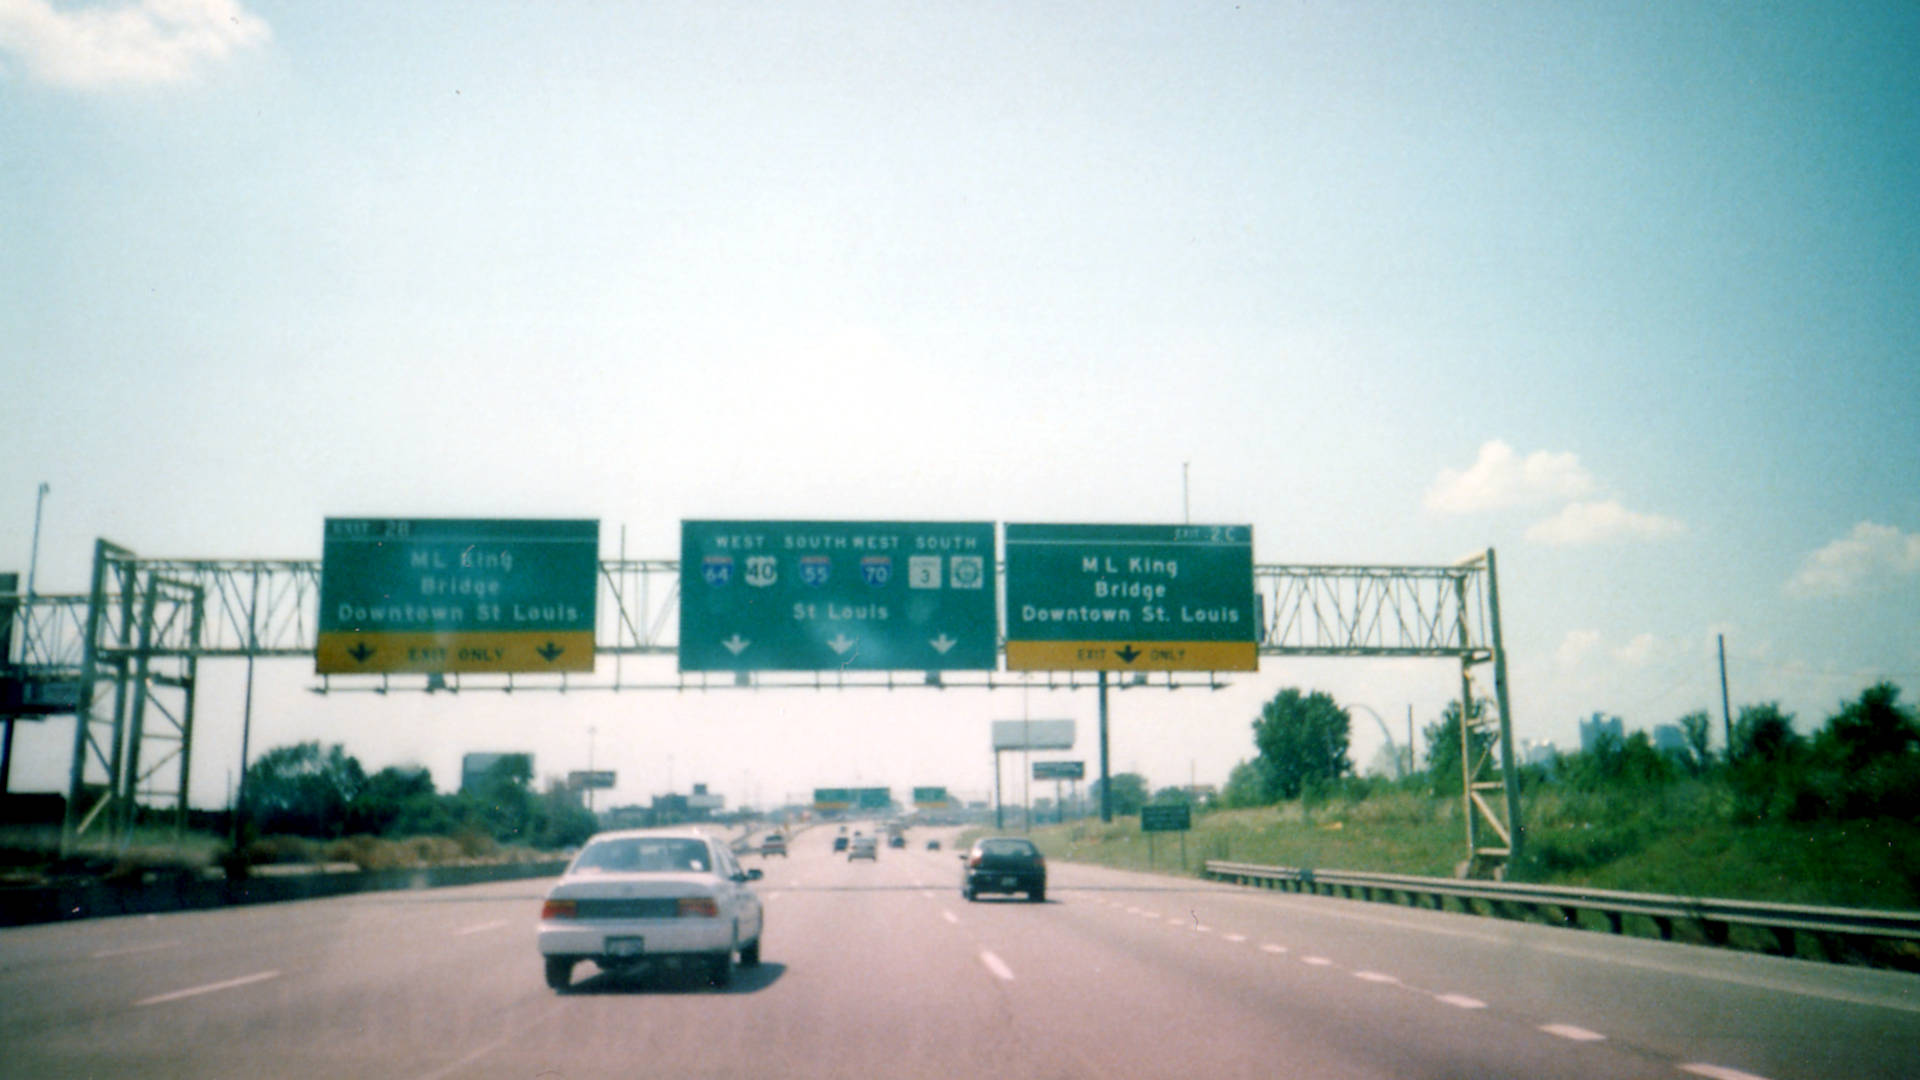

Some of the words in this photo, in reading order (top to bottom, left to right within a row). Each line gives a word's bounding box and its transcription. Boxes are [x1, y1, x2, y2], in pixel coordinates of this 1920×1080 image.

[715, 536, 765, 549] WEST
[784, 536, 847, 549] SOUTH
[852, 536, 899, 549] WEST
[915, 536, 977, 549] SOUTH
[1210, 527, 1236, 542] 2C
[460, 551, 513, 572] King
[1128, 557, 1178, 579] King
[705, 567, 729, 582] 64
[748, 563, 775, 580] 40
[804, 567, 828, 583] 55
[864, 566, 888, 583] 70
[920, 569, 930, 583] 3
[421, 576, 500, 598] Bridge
[1095, 581, 1166, 602] Bridge
[338, 603, 463, 622] Downtown
[476, 603, 500, 622] St
[513, 603, 579, 622] Louis
[793, 603, 816, 620] St
[827, 603, 889, 620] Louis
[1021, 605, 1131, 622] Downtown
[1142, 605, 1170, 622] St.
[1181, 605, 1240, 622] Louis
[408, 646, 447, 662] EXIT
[458, 646, 505, 661] ONLY
[1077, 648, 1106, 661] EXIT
[1151, 648, 1186, 661] ONLY
